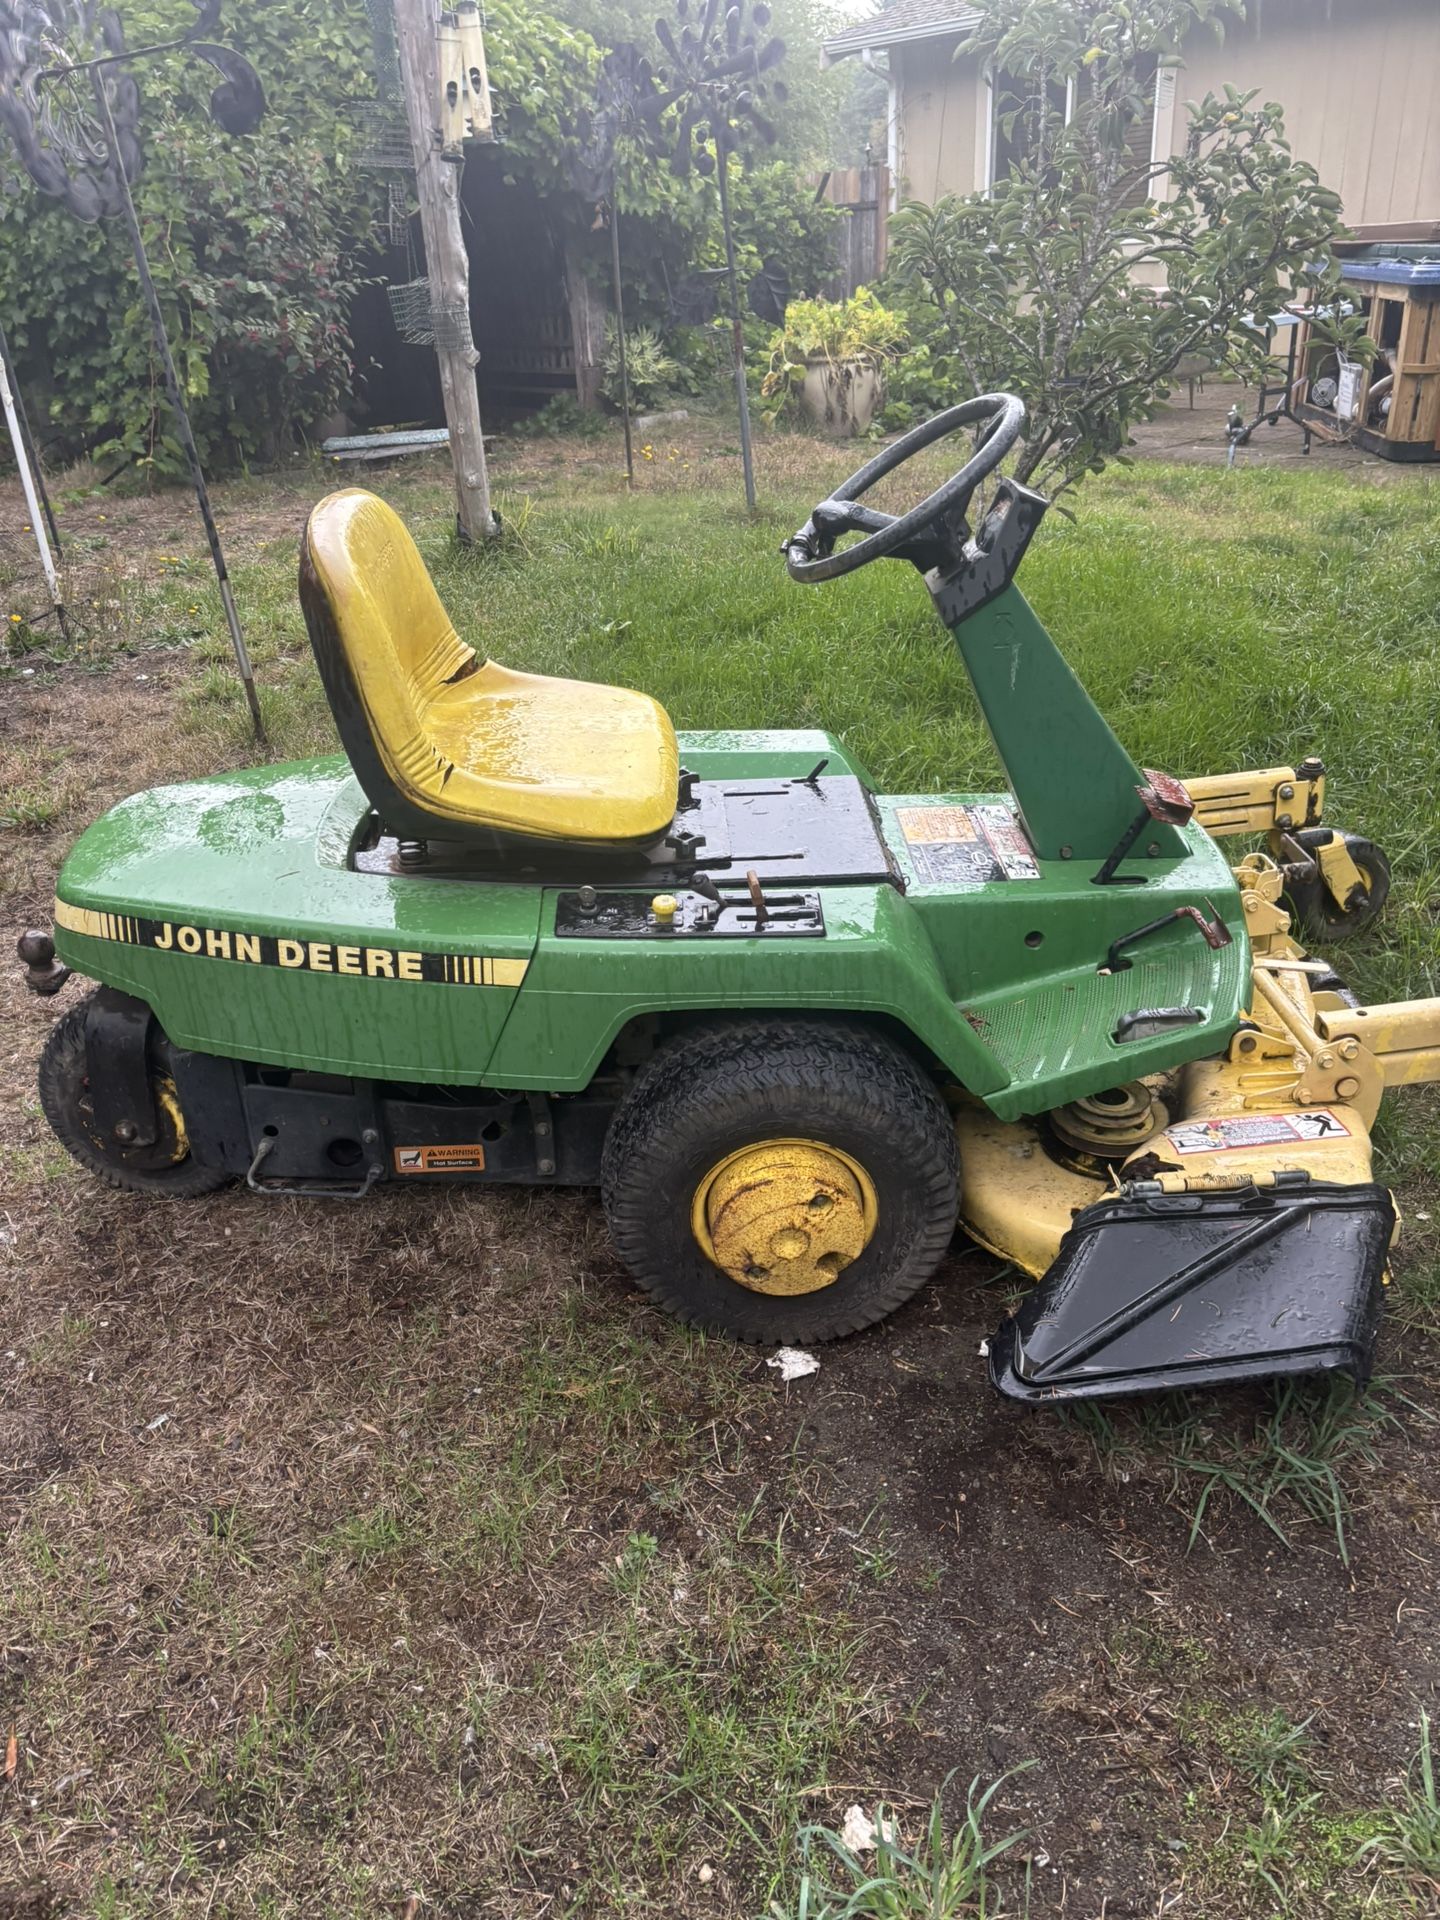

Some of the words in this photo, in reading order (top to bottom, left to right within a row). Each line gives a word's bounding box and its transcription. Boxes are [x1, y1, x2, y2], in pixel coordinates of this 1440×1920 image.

[154, 923, 262, 963] JOHN
[278, 939, 424, 980] DEERE
[437, 1149, 480, 1157] WARNING
